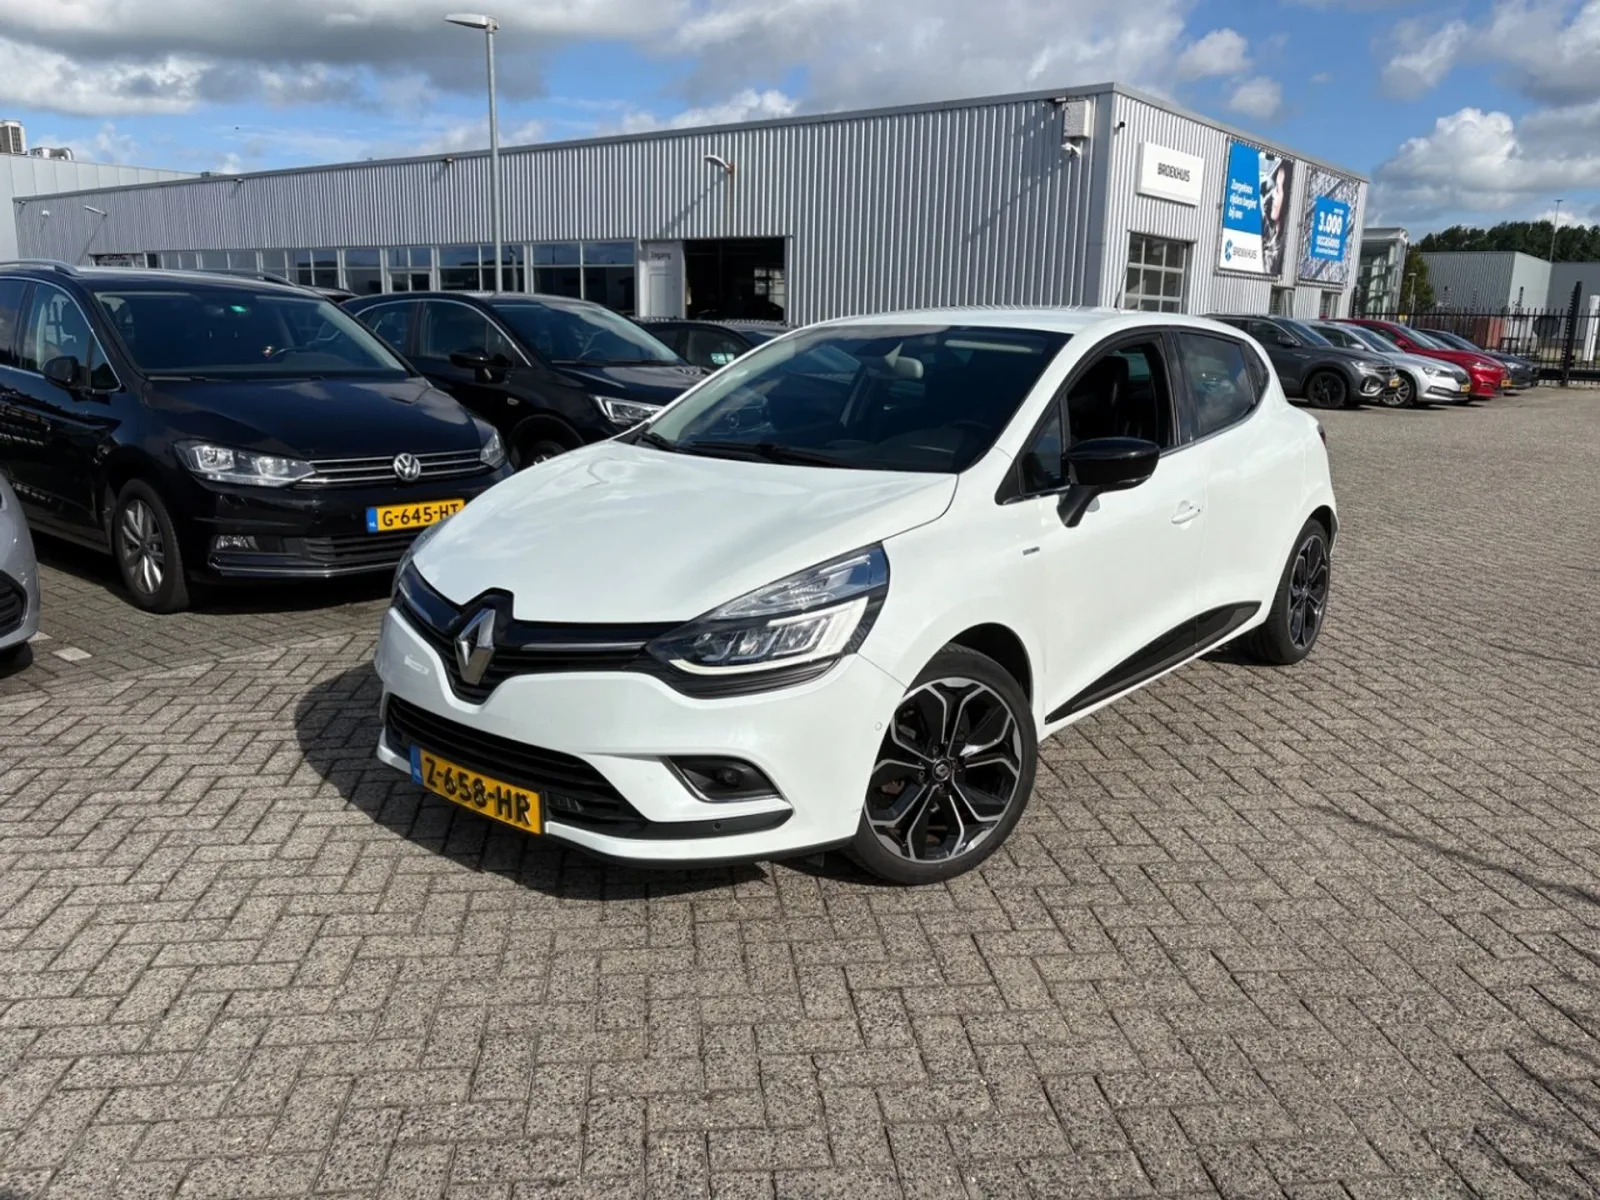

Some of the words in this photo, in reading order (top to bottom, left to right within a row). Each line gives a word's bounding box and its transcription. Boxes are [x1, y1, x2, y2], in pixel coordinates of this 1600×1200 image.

[1157, 162, 1190, 182] BROEKHUIS
[1318, 211, 1343, 236] 3.000
[1232, 246, 1258, 259] BROEKHUIS
[382, 503, 459, 527] G-645-HT
[425, 757, 531, 826] Z-658-HR
